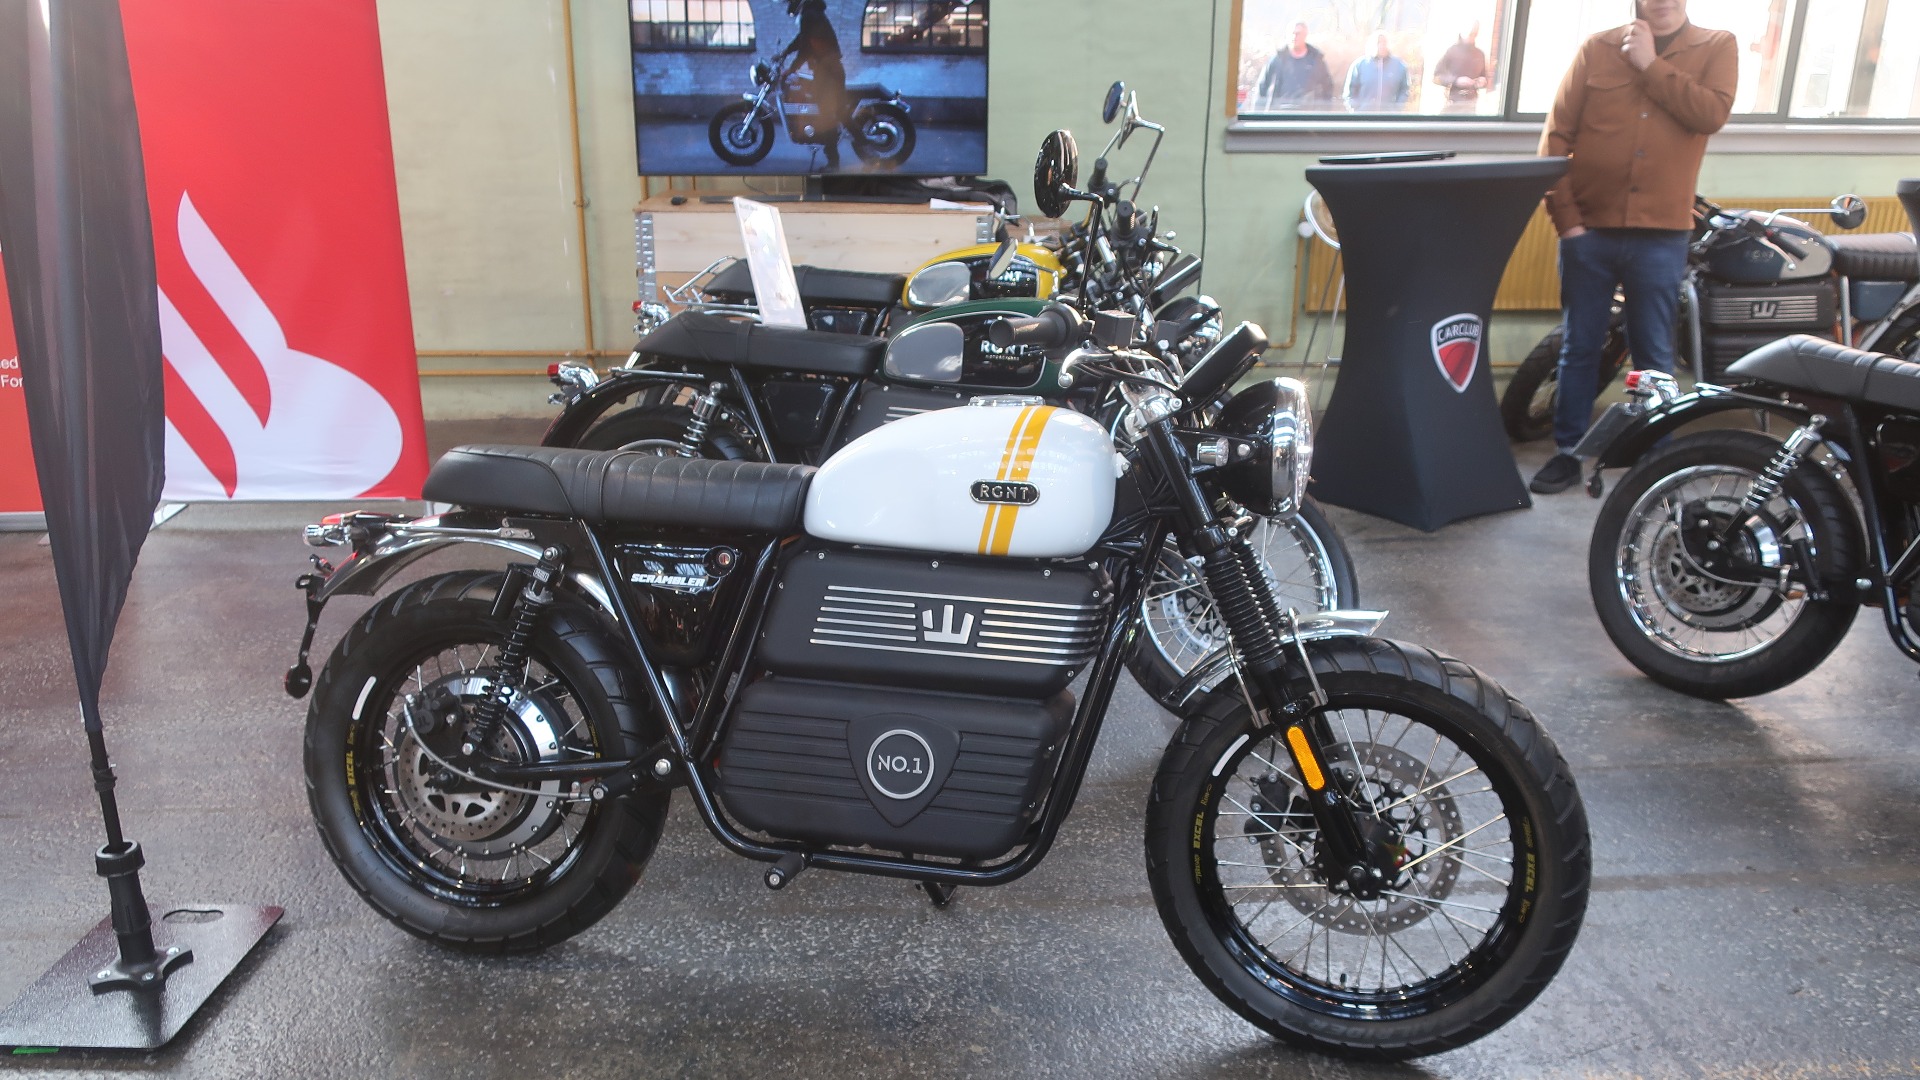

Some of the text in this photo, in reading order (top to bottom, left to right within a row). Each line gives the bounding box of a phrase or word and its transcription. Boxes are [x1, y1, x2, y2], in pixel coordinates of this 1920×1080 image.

[1437, 322, 1480, 342] CARCLUB
[980, 483, 1029, 500] RGNT
[630, 573, 706, 587] SCRAMBLER
[345, 751, 355, 786] EXCEL
[878, 754, 923, 774] NO.1
[1193, 811, 1204, 849] EXCEL
[1525, 853, 1536, 893] EXCEL
